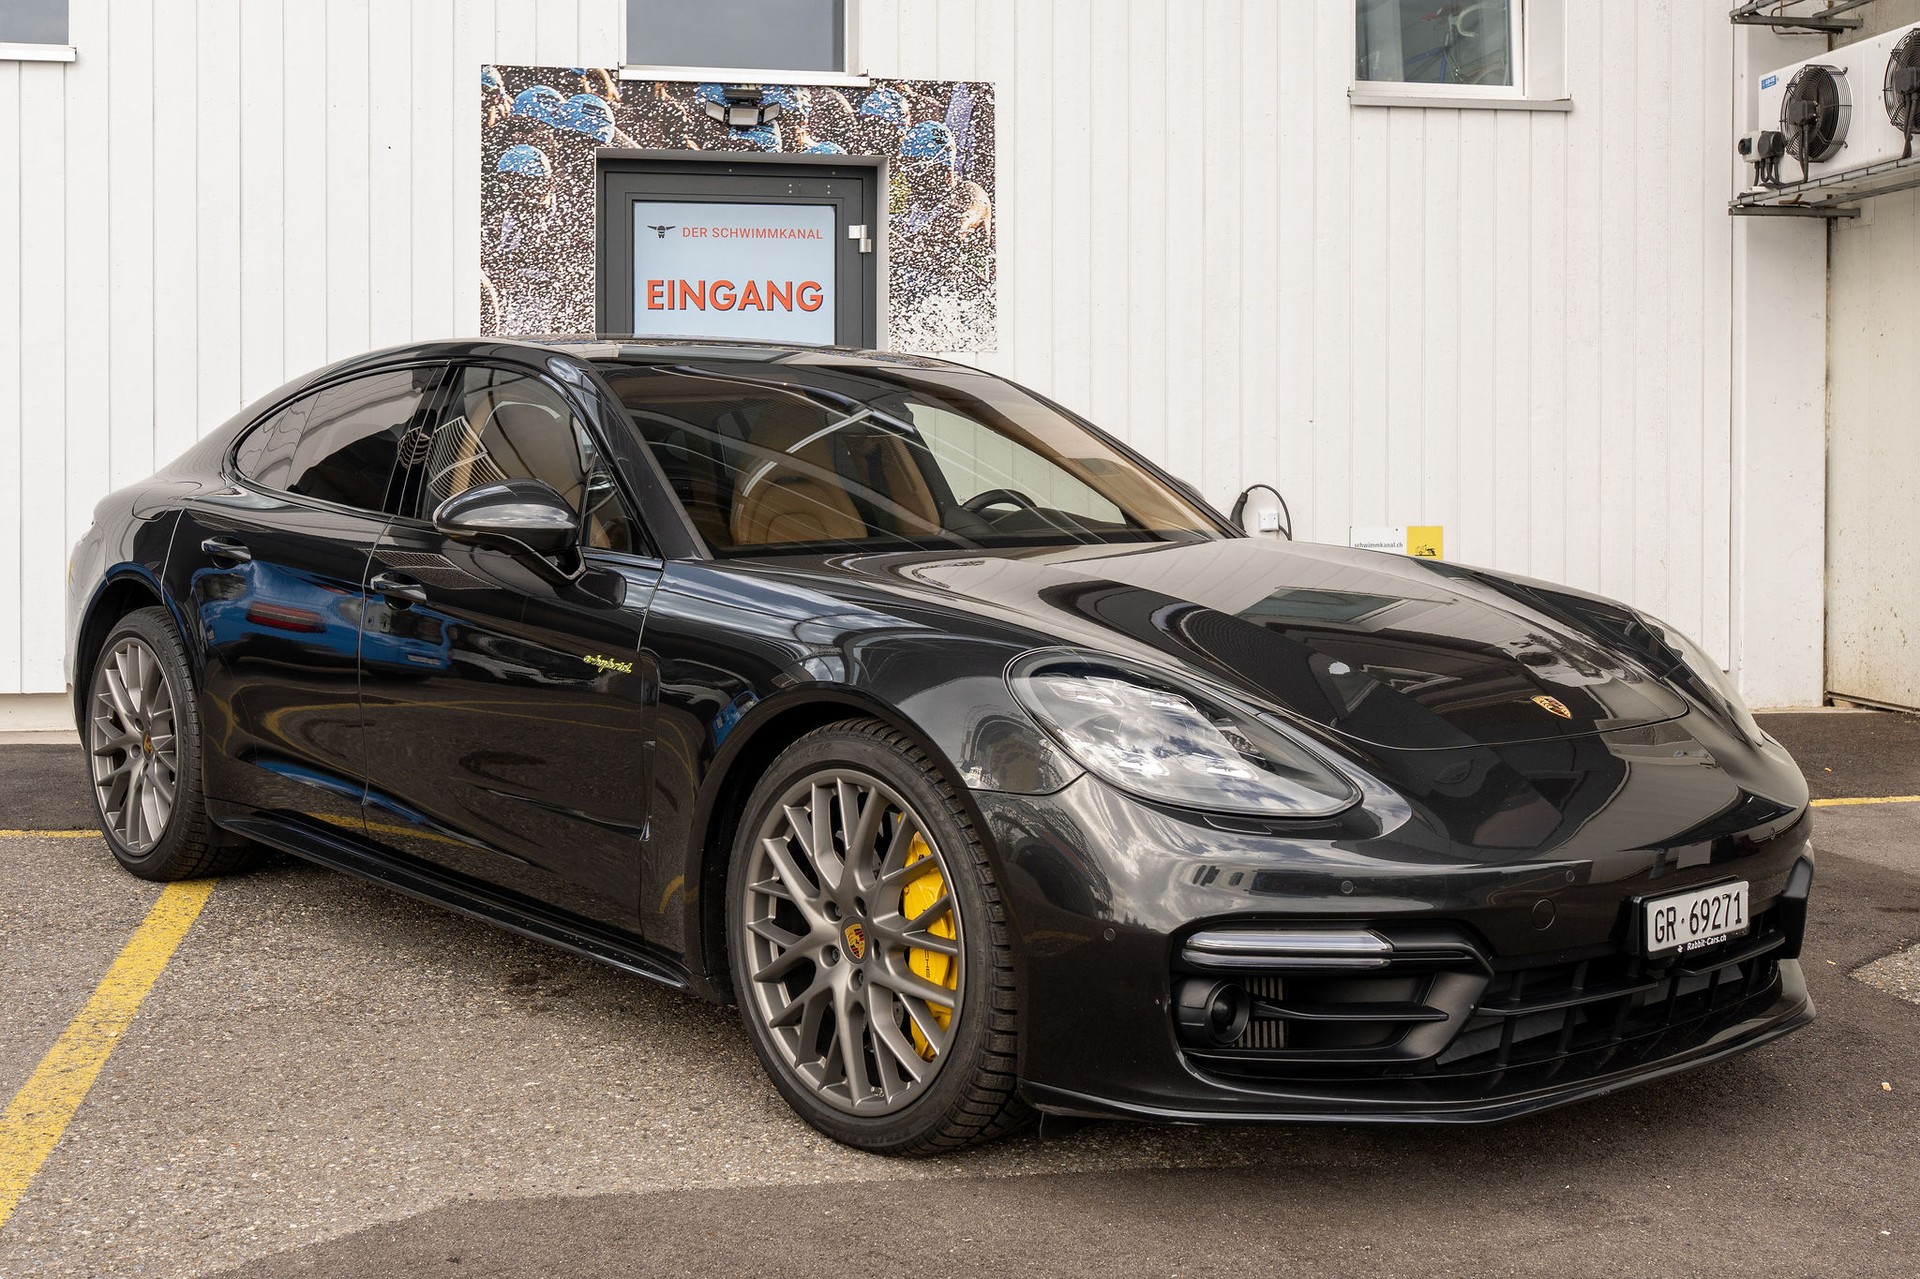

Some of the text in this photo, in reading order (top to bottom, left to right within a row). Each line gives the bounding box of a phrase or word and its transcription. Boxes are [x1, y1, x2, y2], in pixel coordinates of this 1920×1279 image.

[682, 227, 823, 240] DER SCHWIMMKANAL
[647, 279, 824, 312] EINGANG
